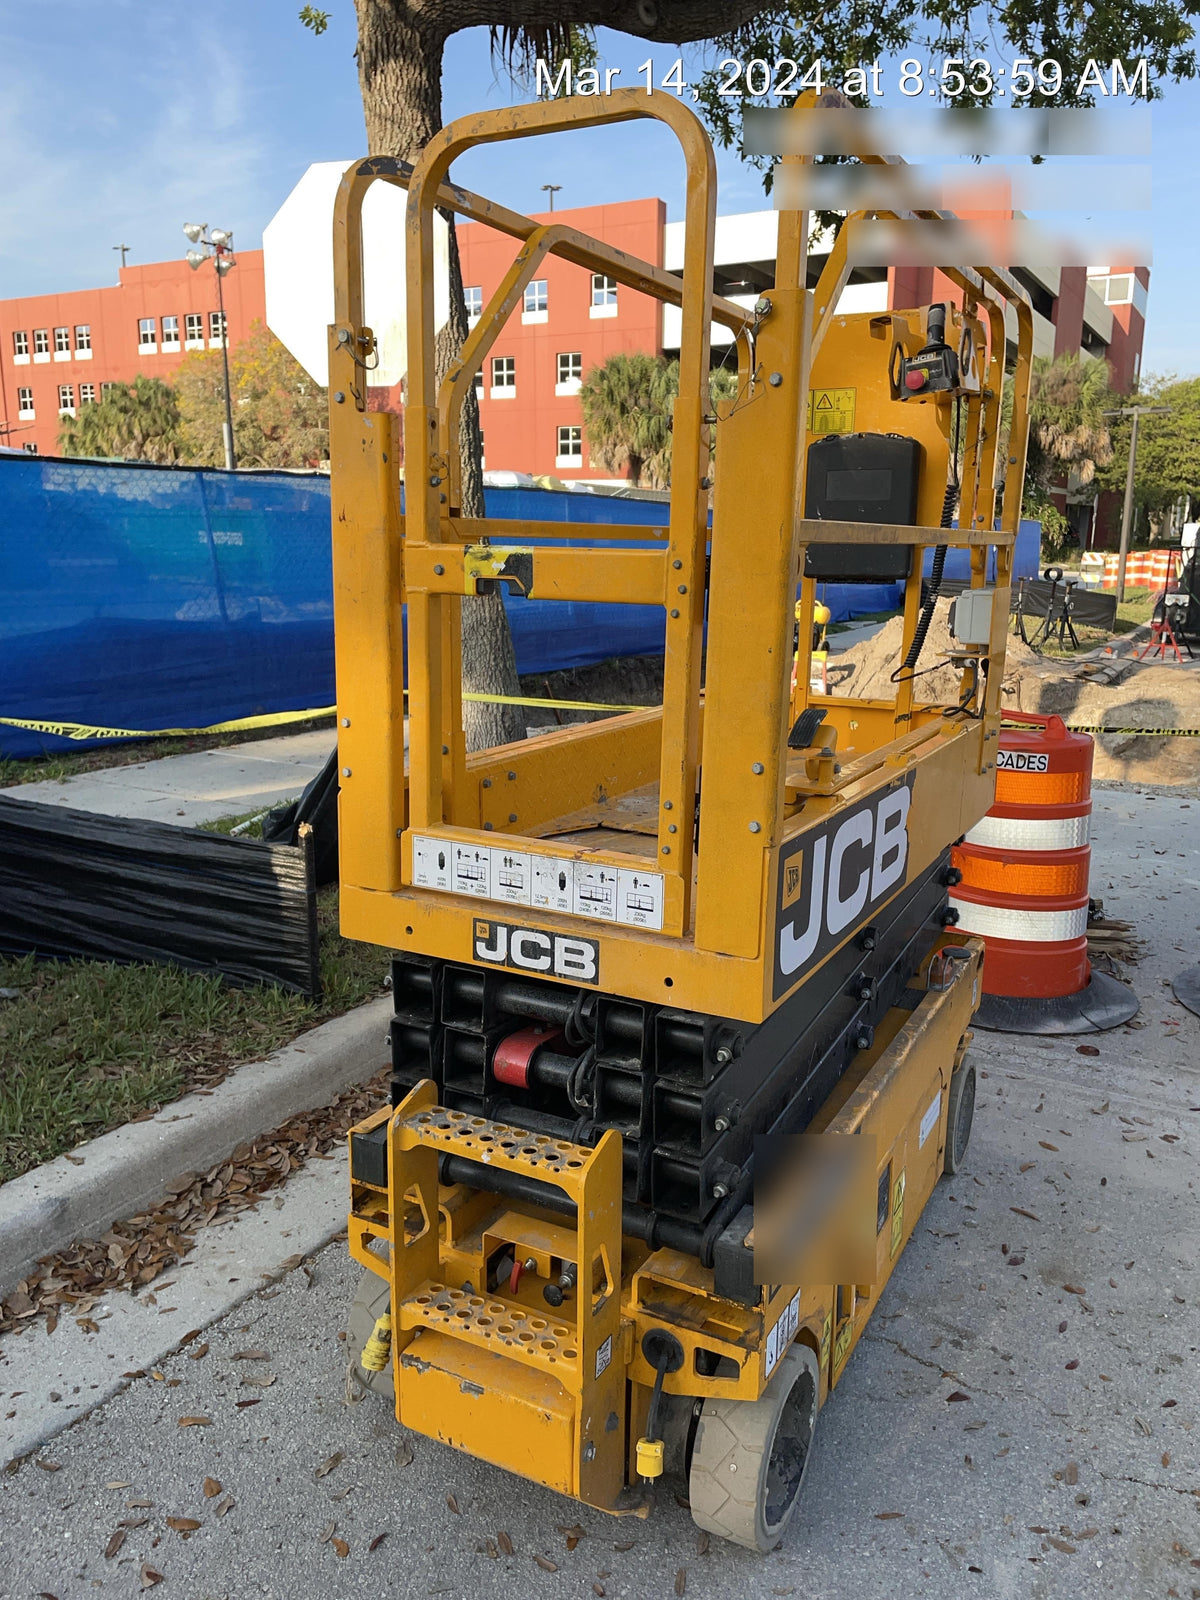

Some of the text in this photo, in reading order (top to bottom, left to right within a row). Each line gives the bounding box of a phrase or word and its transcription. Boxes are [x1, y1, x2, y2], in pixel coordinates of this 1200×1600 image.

[914, 353, 934, 362] JCB
[779, 785, 911, 975] JCB
[475, 926, 596, 980] JCB
